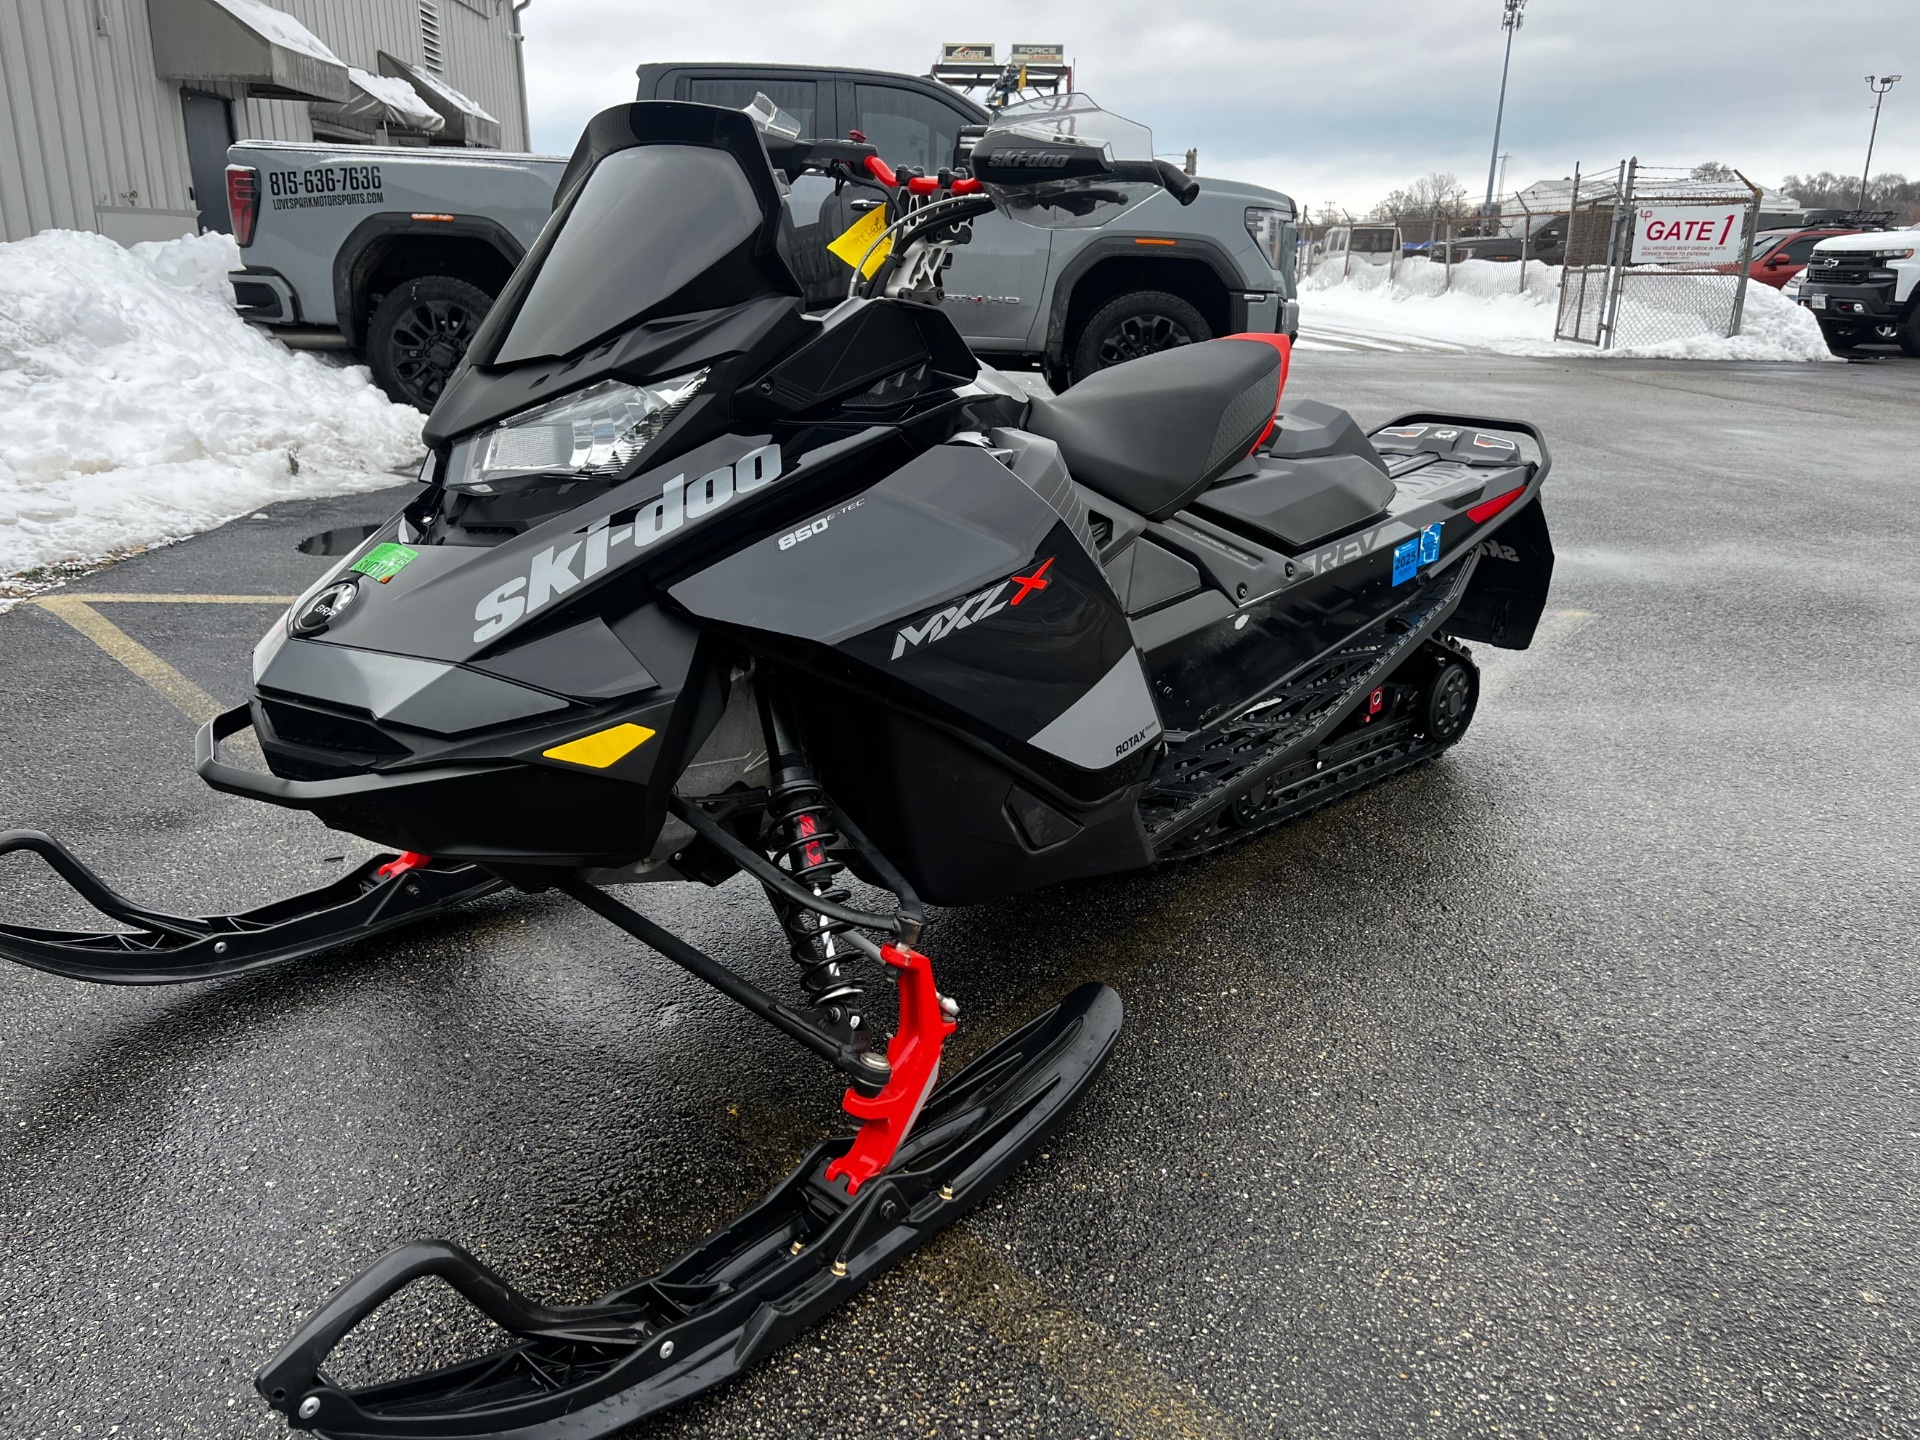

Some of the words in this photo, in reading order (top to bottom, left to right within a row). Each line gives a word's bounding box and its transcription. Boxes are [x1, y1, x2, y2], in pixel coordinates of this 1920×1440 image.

[988, 150, 1070, 168] ski-doo
[269, 166, 382, 196] 815-636-7636
[272, 192, 384, 211] LOVESPARKMOTORSPORTS.COM
[1646, 221, 1716, 241] GATE
[1718, 214, 1736, 246] 1
[778, 517, 829, 551] 850
[827, 498, 865, 520] E-TEC
[473, 443, 782, 643] ski-doo
[1312, 526, 1383, 576] REV
[355, 559, 393, 579] SNOW
[1394, 551, 1417, 571] 2025
[1010, 557, 1055, 606] X
[315, 604, 337, 617] BRP
[1115, 728, 1146, 757] ROTAX
